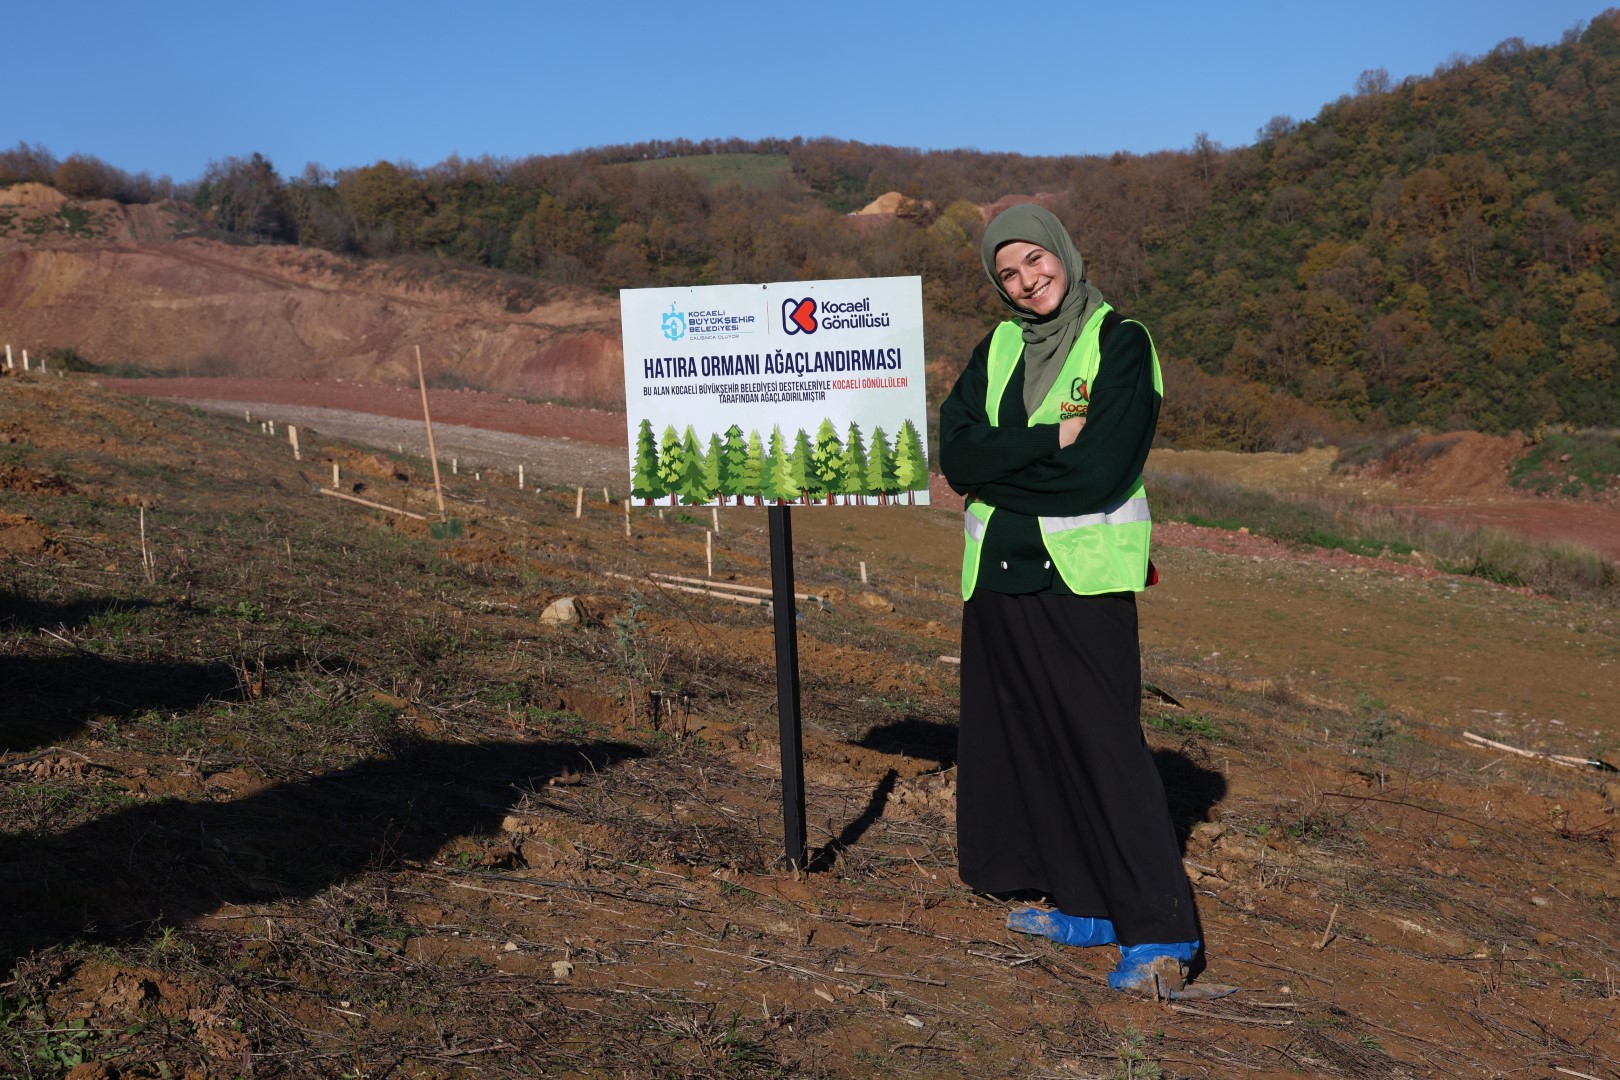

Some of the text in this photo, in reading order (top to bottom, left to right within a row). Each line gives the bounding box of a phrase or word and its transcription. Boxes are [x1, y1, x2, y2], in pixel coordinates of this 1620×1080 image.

[822, 298, 870, 313] Kocaeli
[689, 316, 755, 325] BÜYÜKŞEHİR
[822, 313, 890, 329] Gönüllüsü
[644, 348, 901, 379] HATIRA ORMANI AĞAÇLANDIRMASI
[644, 376, 908, 396] BU ALAN KOCAELİ BÜYÜKŞEHİR BELEDİYESİ DESTEKLERİYLE KOCAELİ GÖNÜLLÜLERİ
[719, 394, 759, 404] TARAFINDAN
[1060, 402, 1088, 412] Koca
